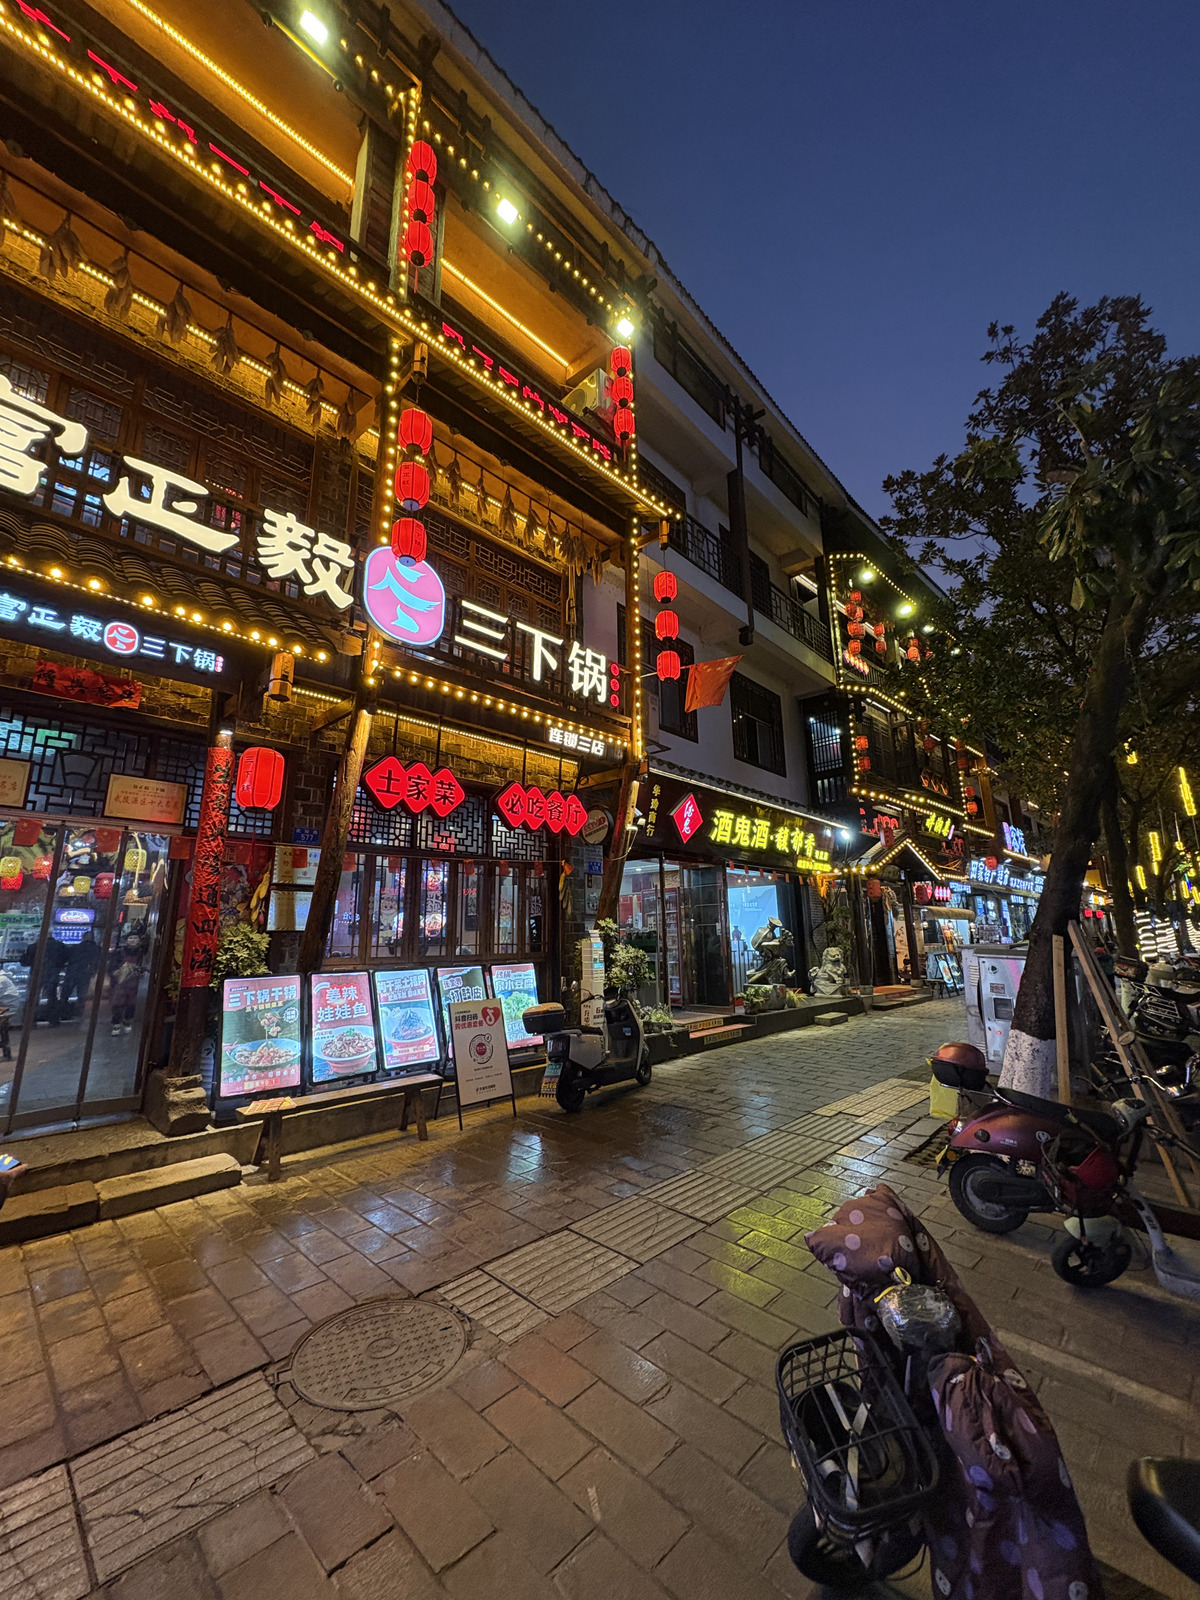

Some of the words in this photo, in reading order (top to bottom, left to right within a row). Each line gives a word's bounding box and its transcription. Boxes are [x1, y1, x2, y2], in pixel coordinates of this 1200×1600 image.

[139, 636, 216, 672] 三下锅
[455, 599, 607, 703] 三下锅
[375, 770, 457, 807] 土家菜
[504, 792, 587, 827] 必吃餐厅
[300, 834, 314, 842] 577
[228, 984, 297, 1008] 三下锅干锅
[325, 985, 359, 1003] 姜辣
[317, 1002, 369, 1023] 娃娃鱼
[455, 1013, 478, 1023] 抖音扫码
